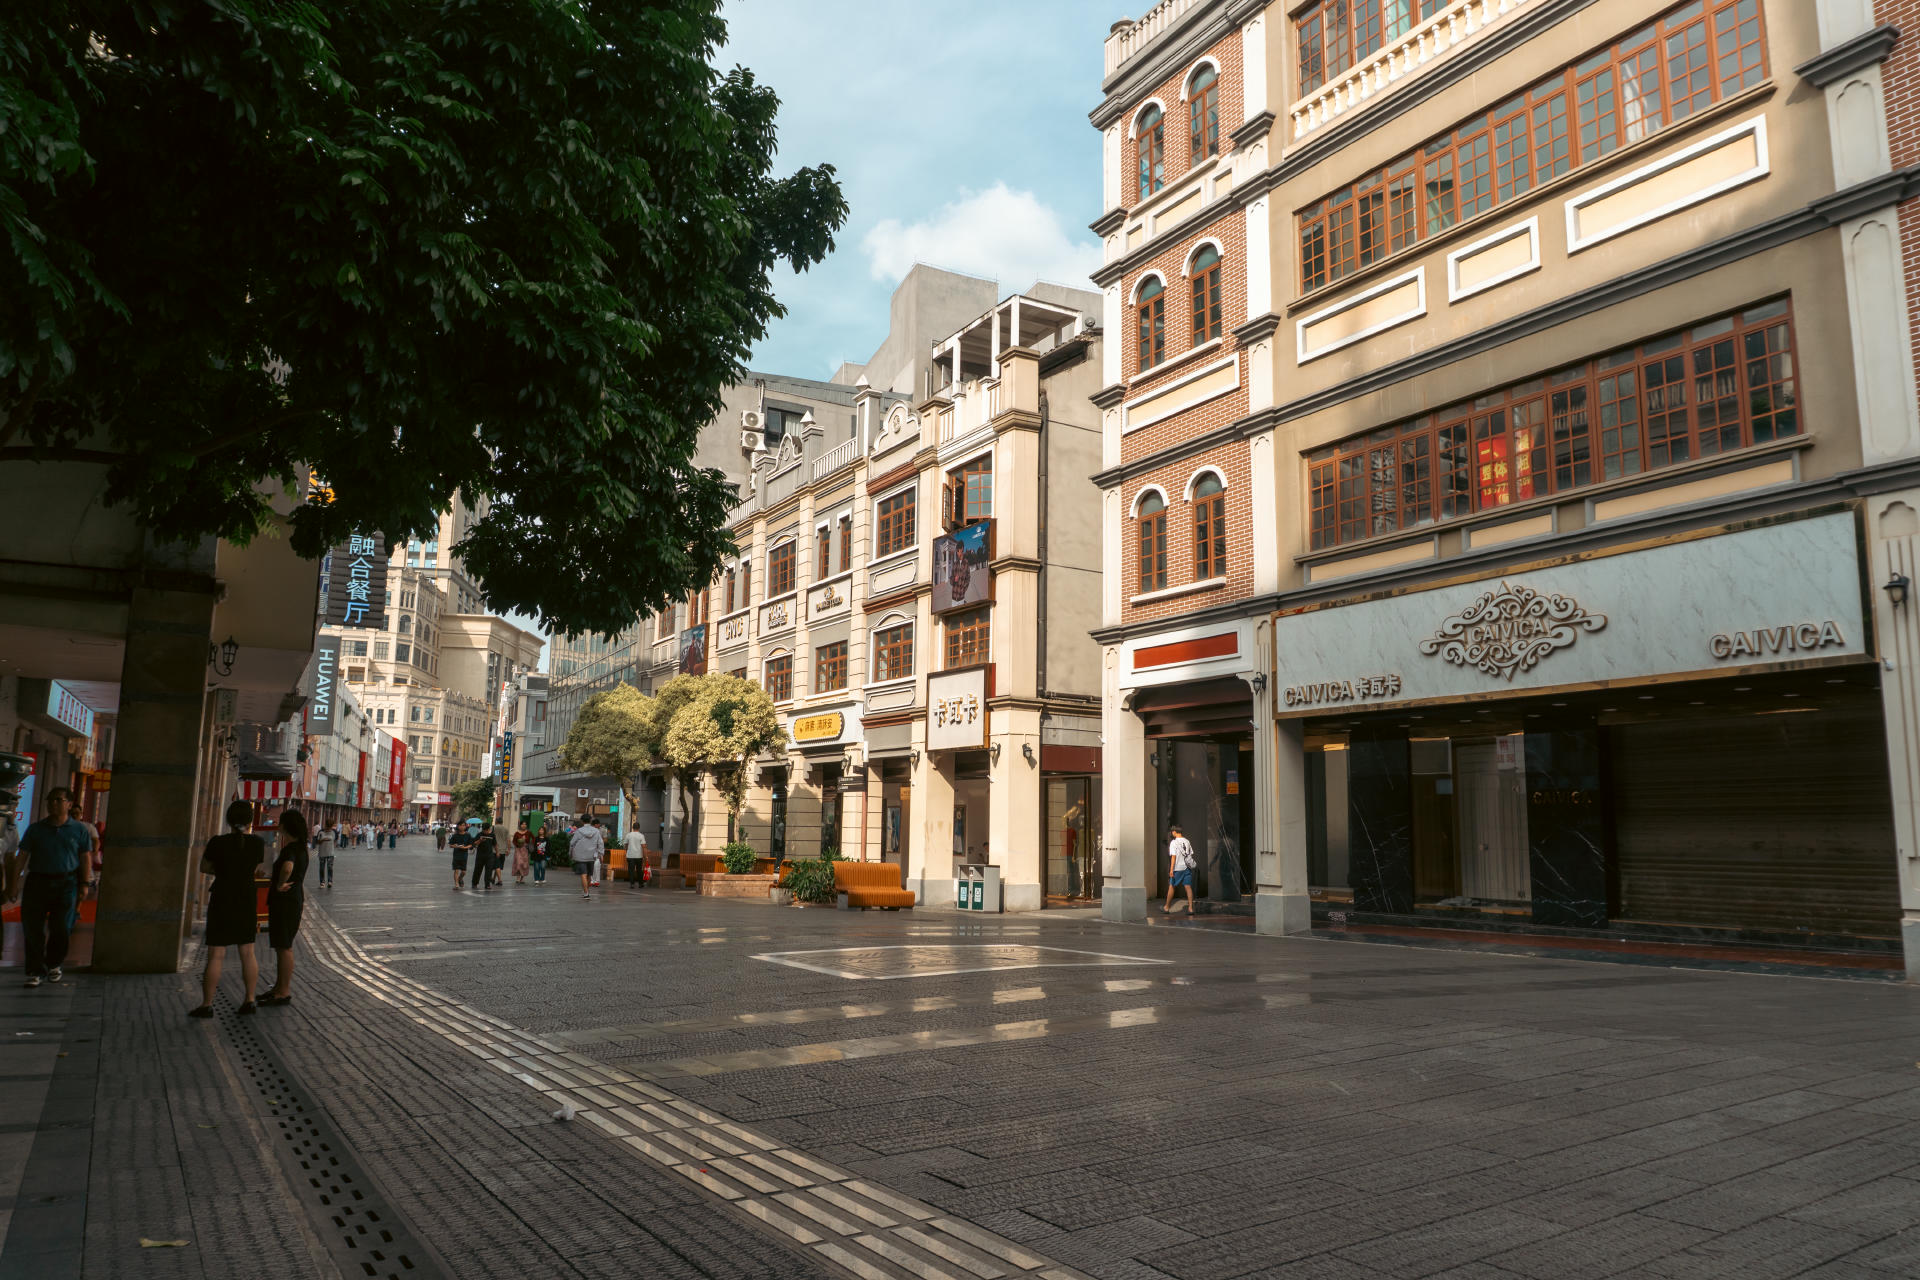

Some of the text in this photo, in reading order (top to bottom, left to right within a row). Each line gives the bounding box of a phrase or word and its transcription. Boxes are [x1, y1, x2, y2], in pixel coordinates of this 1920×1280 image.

[1470, 618, 1545, 643] CAIVICA
[1709, 620, 1845, 660] CAIVICA
[313, 648, 335, 721] HUAWEI
[1283, 674, 1402, 707] CAIVICA 卡瓦卡
[933, 693, 978, 728] 卡瓦卡
